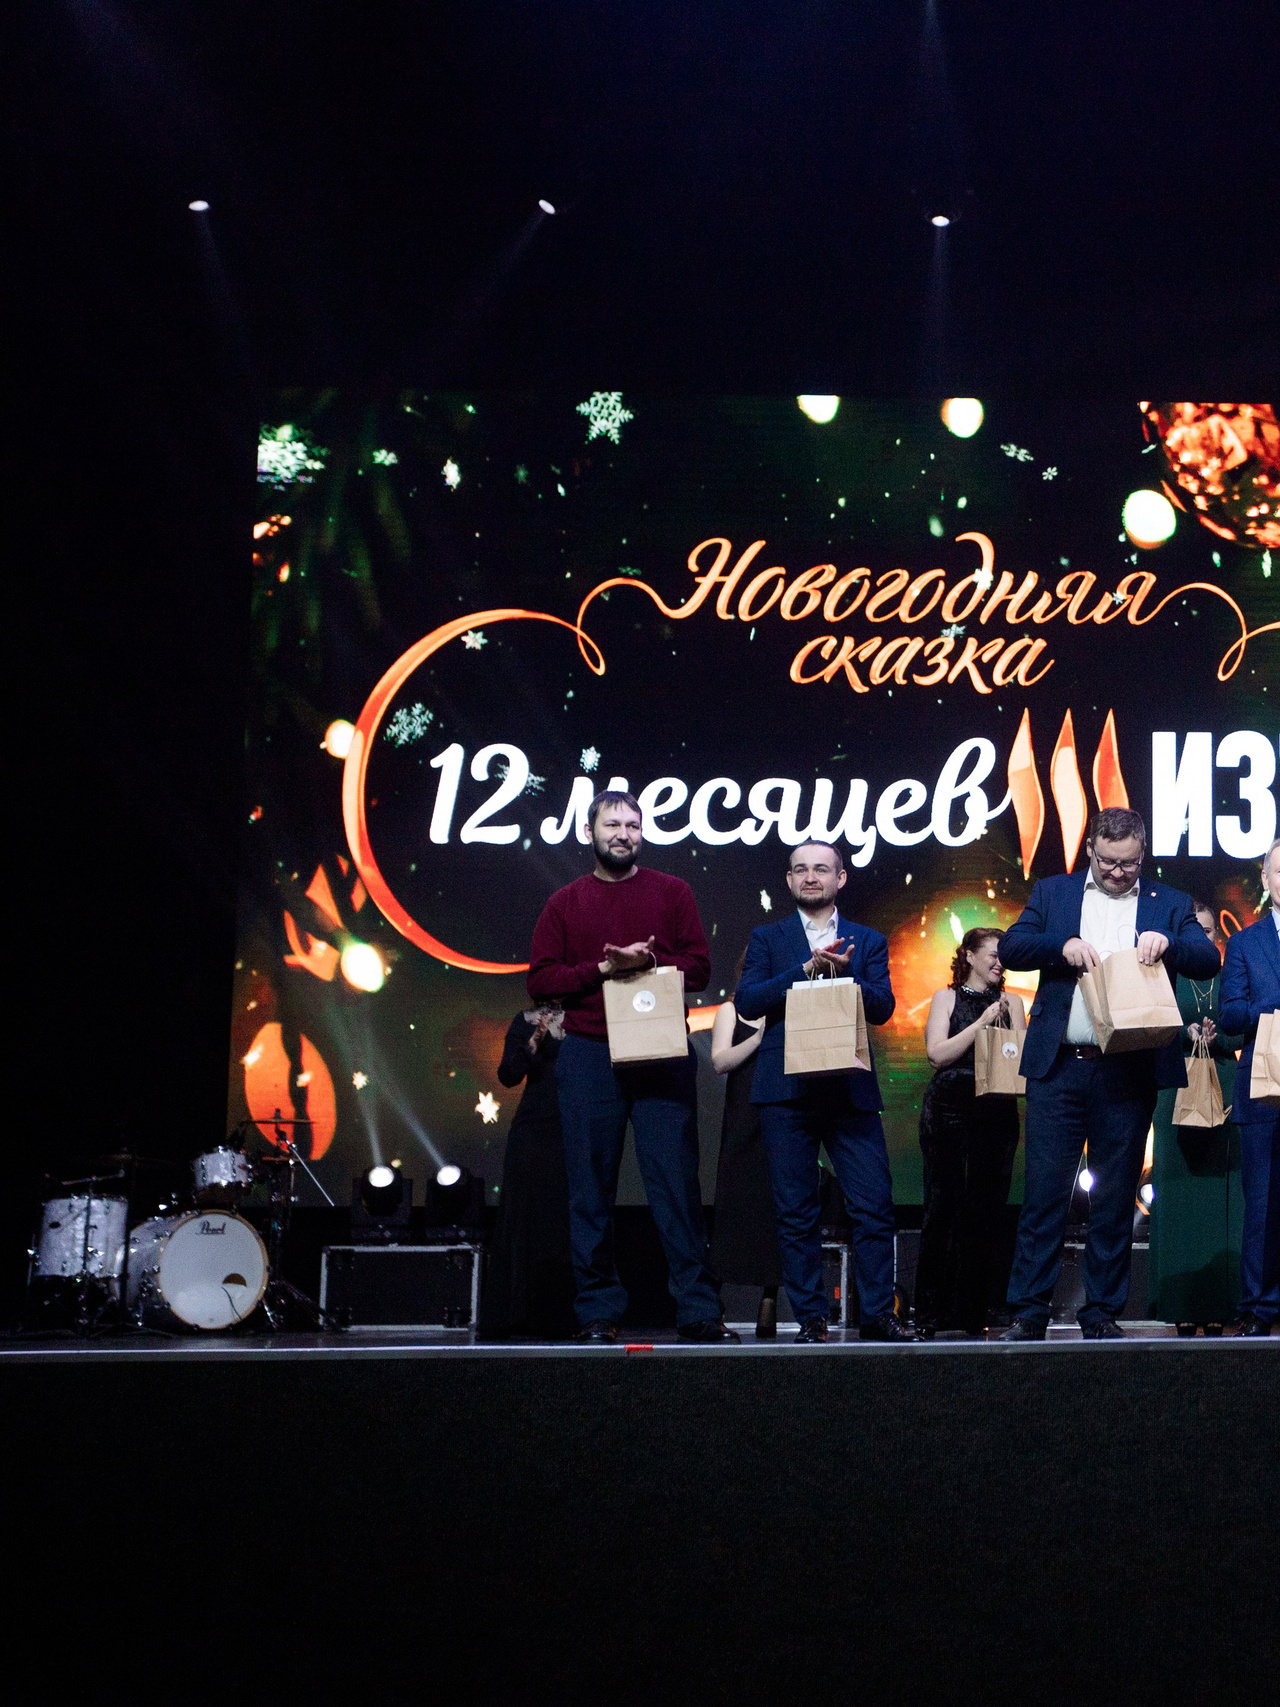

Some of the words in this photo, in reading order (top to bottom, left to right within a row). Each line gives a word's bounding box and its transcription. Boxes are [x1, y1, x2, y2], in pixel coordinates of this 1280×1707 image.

[662, 530, 1168, 625] Новогодняя
[789, 634, 1055, 694] сказка
[429, 742, 530, 845] 12
